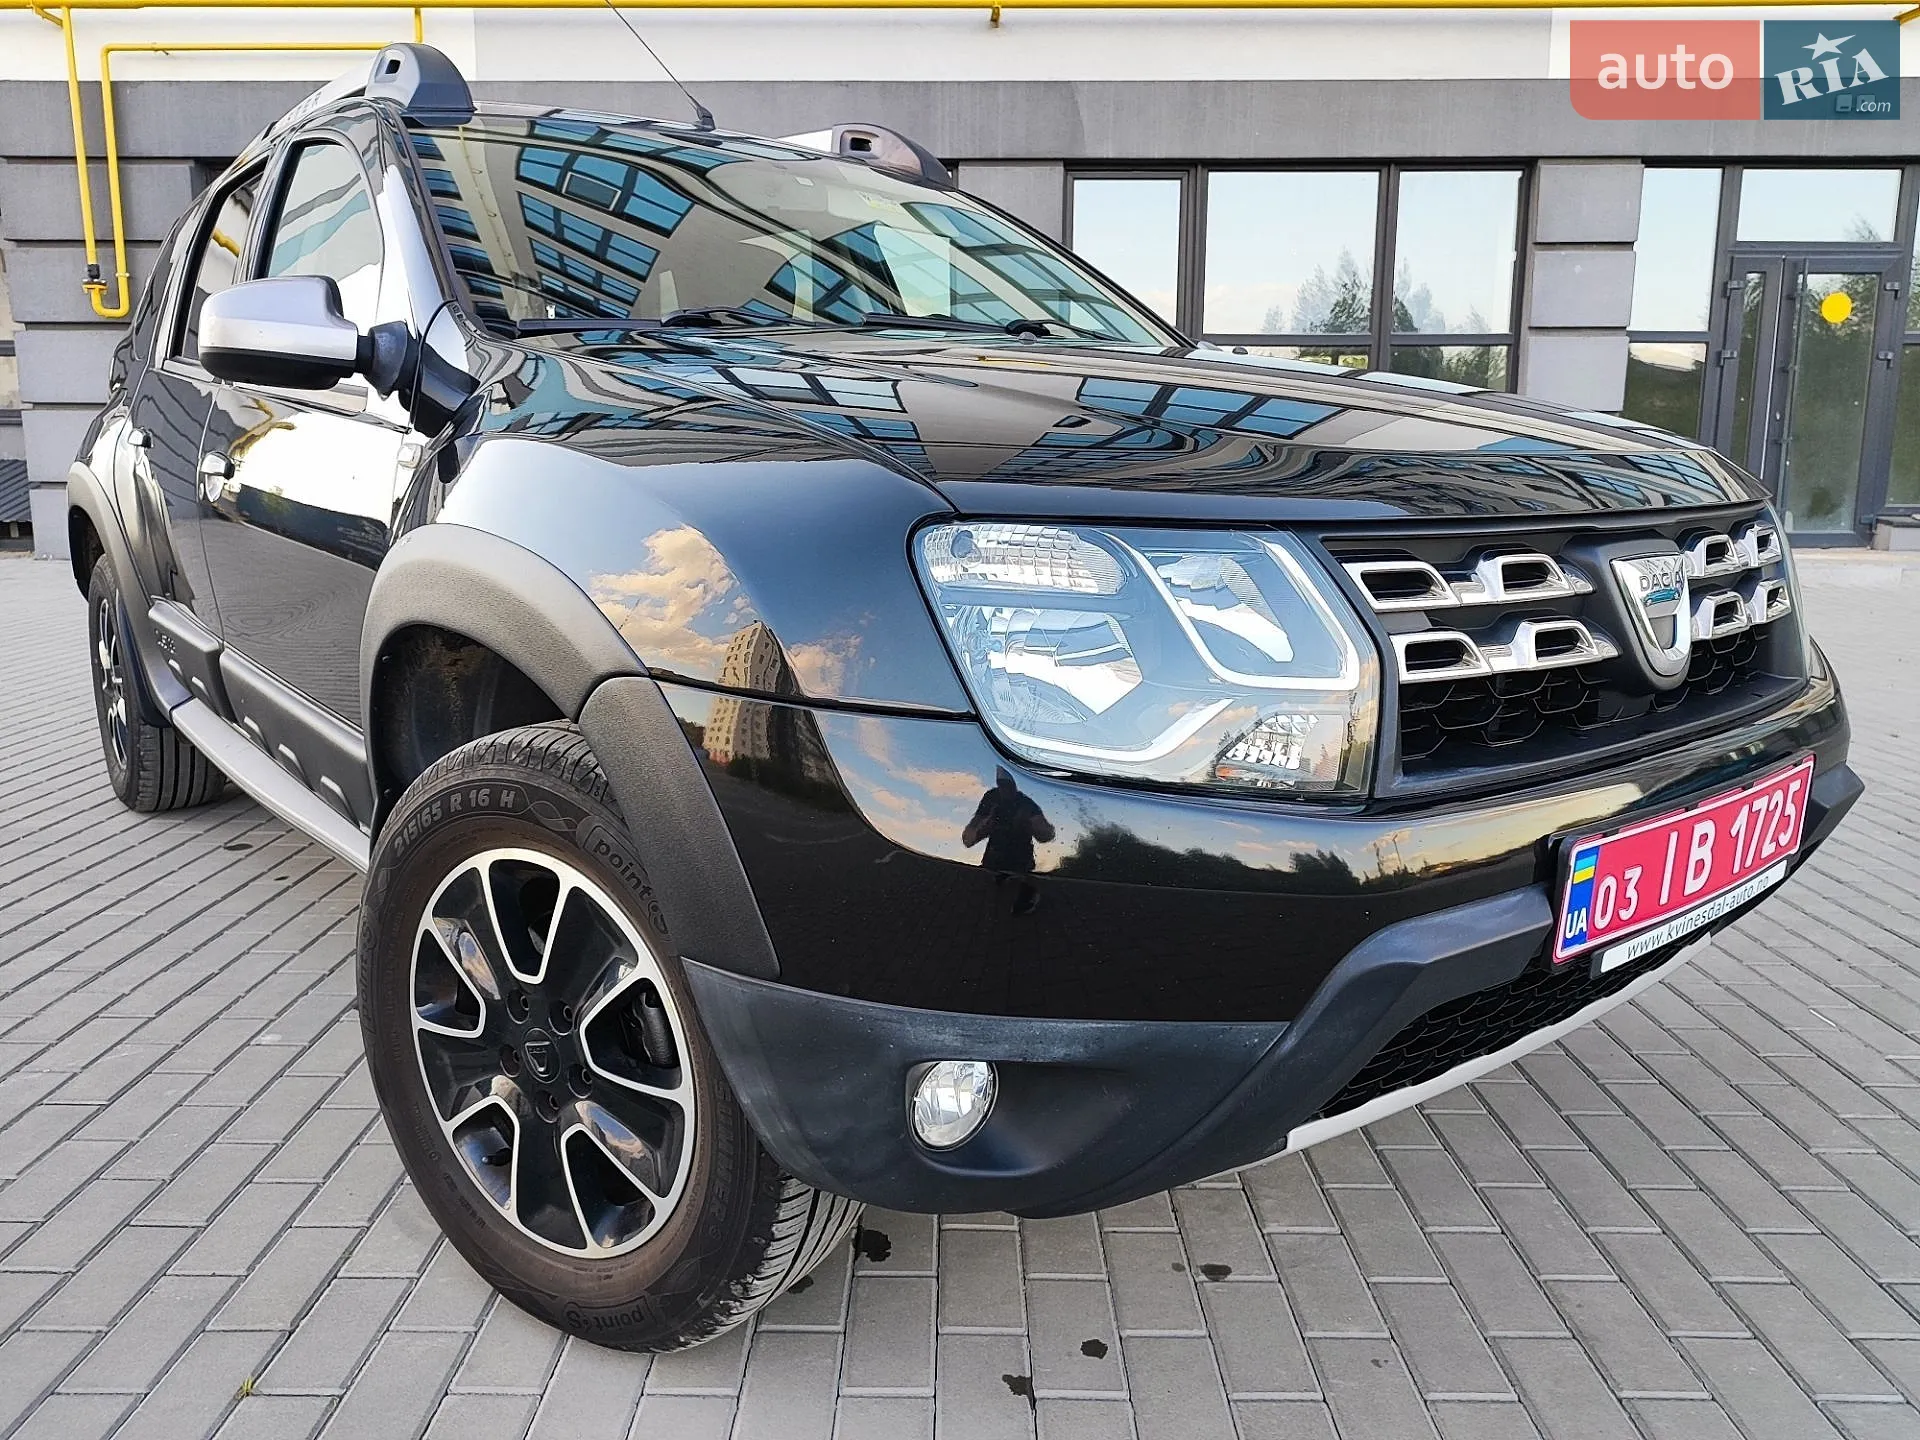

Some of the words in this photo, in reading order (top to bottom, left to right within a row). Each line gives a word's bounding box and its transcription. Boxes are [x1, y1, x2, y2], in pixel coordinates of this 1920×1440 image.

[1639, 570, 1684, 592] DACIA
[393, 801, 443, 857] 215/65
[449, 792, 463, 813] R
[468, 788, 491, 808] 16
[499, 789, 516, 809] H
[1593, 865, 1644, 930] 03
[1658, 818, 1717, 906] IB
[1730, 778, 1802, 875] 1725
[592, 838, 653, 900] point
[1565, 907, 1588, 939] UA
[1626, 875, 1769, 960] www.kvinesdal-auto.no
